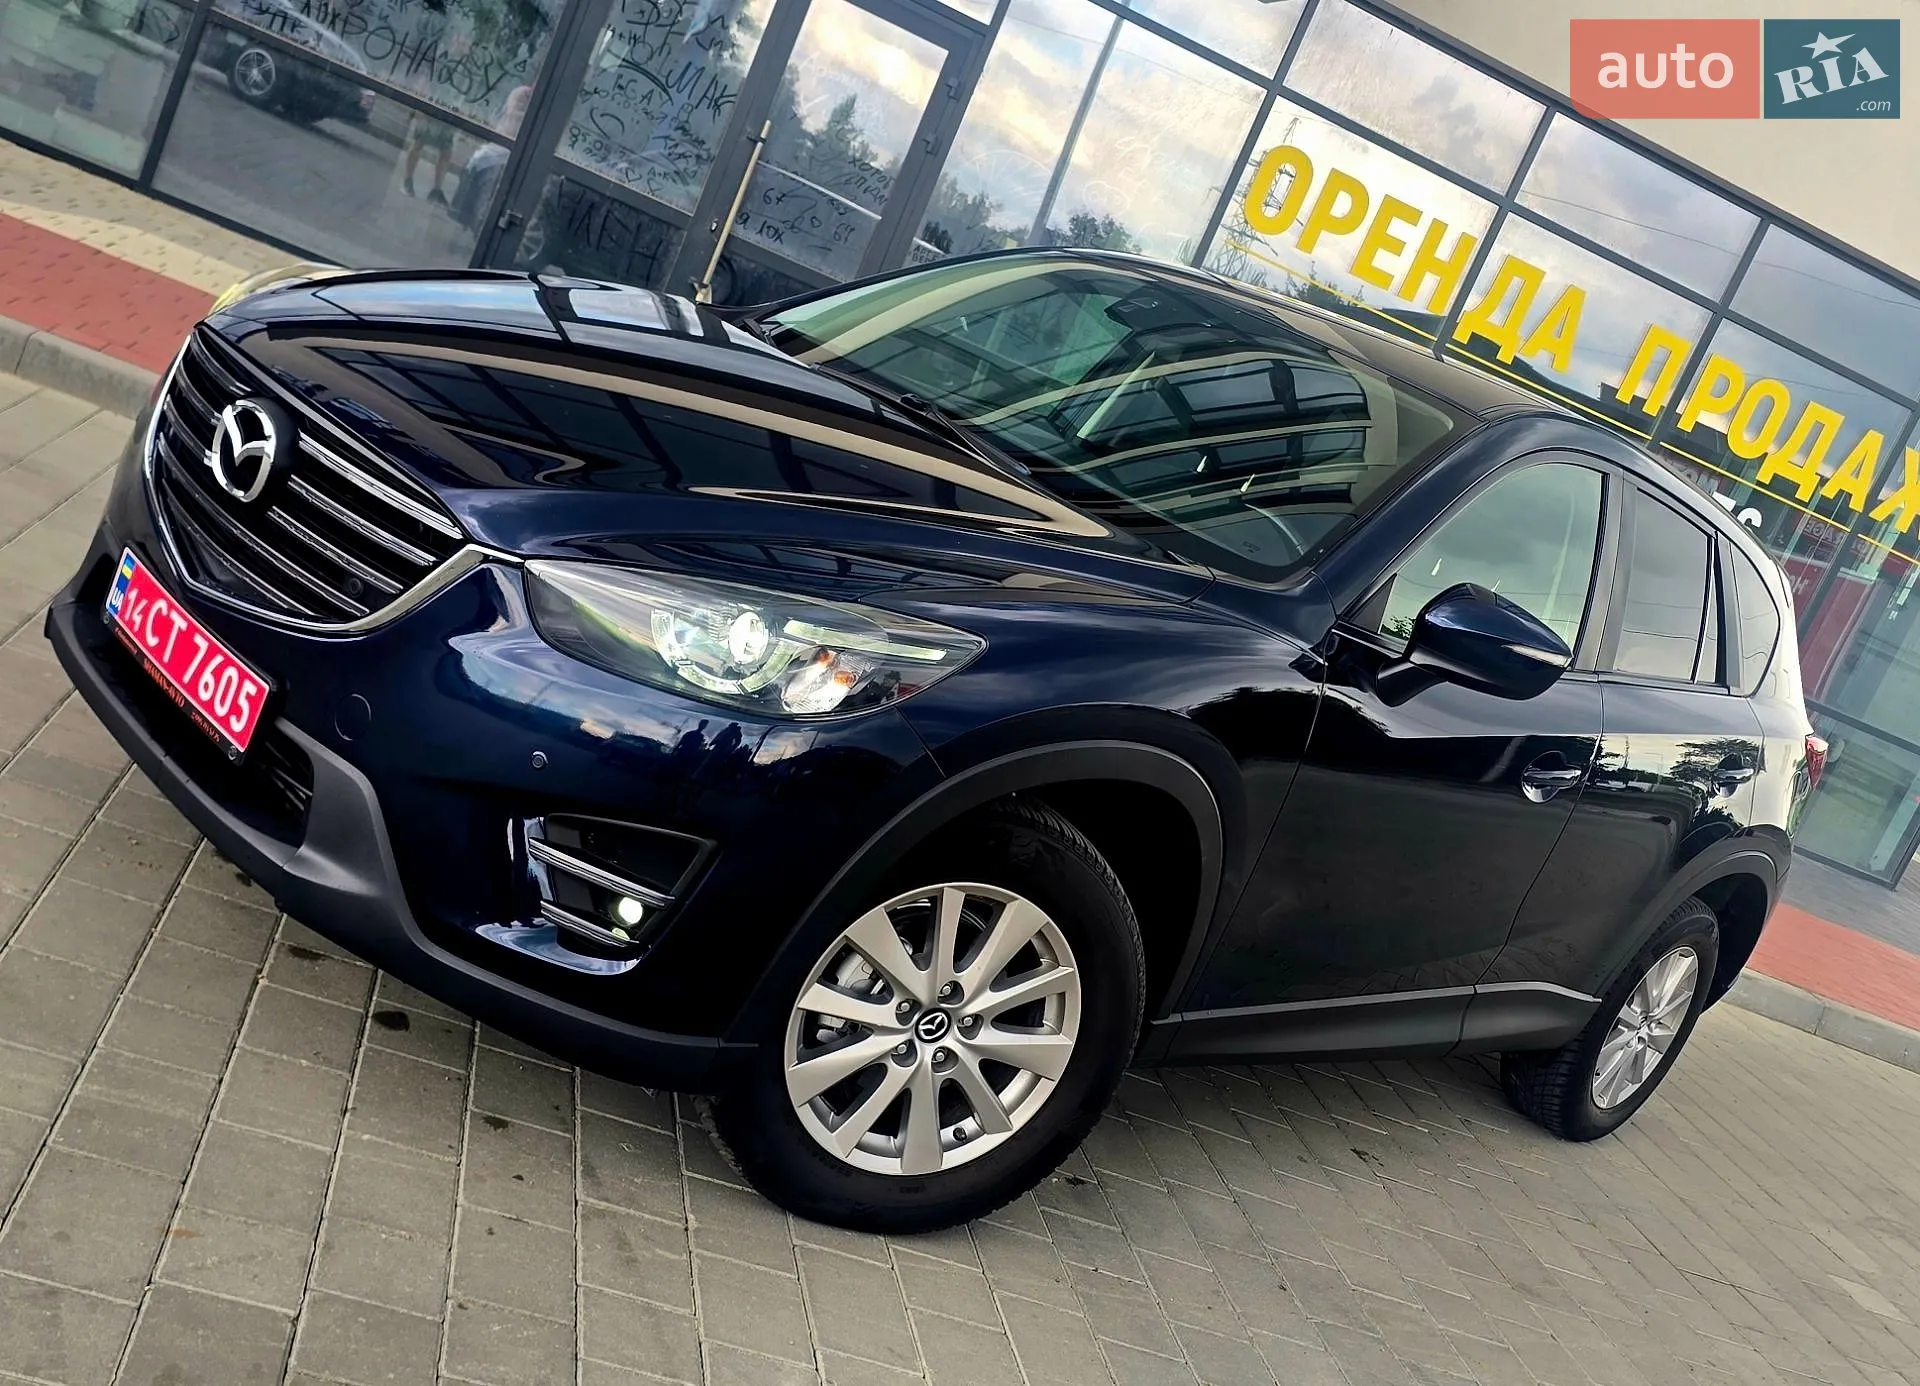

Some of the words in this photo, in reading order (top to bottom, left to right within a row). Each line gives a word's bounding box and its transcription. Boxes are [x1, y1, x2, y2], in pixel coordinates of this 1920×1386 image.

[1245, 147, 1585, 373] ОРЕНДА
[111, 586, 123, 609] UA
[181, 632, 258, 733] 7605
